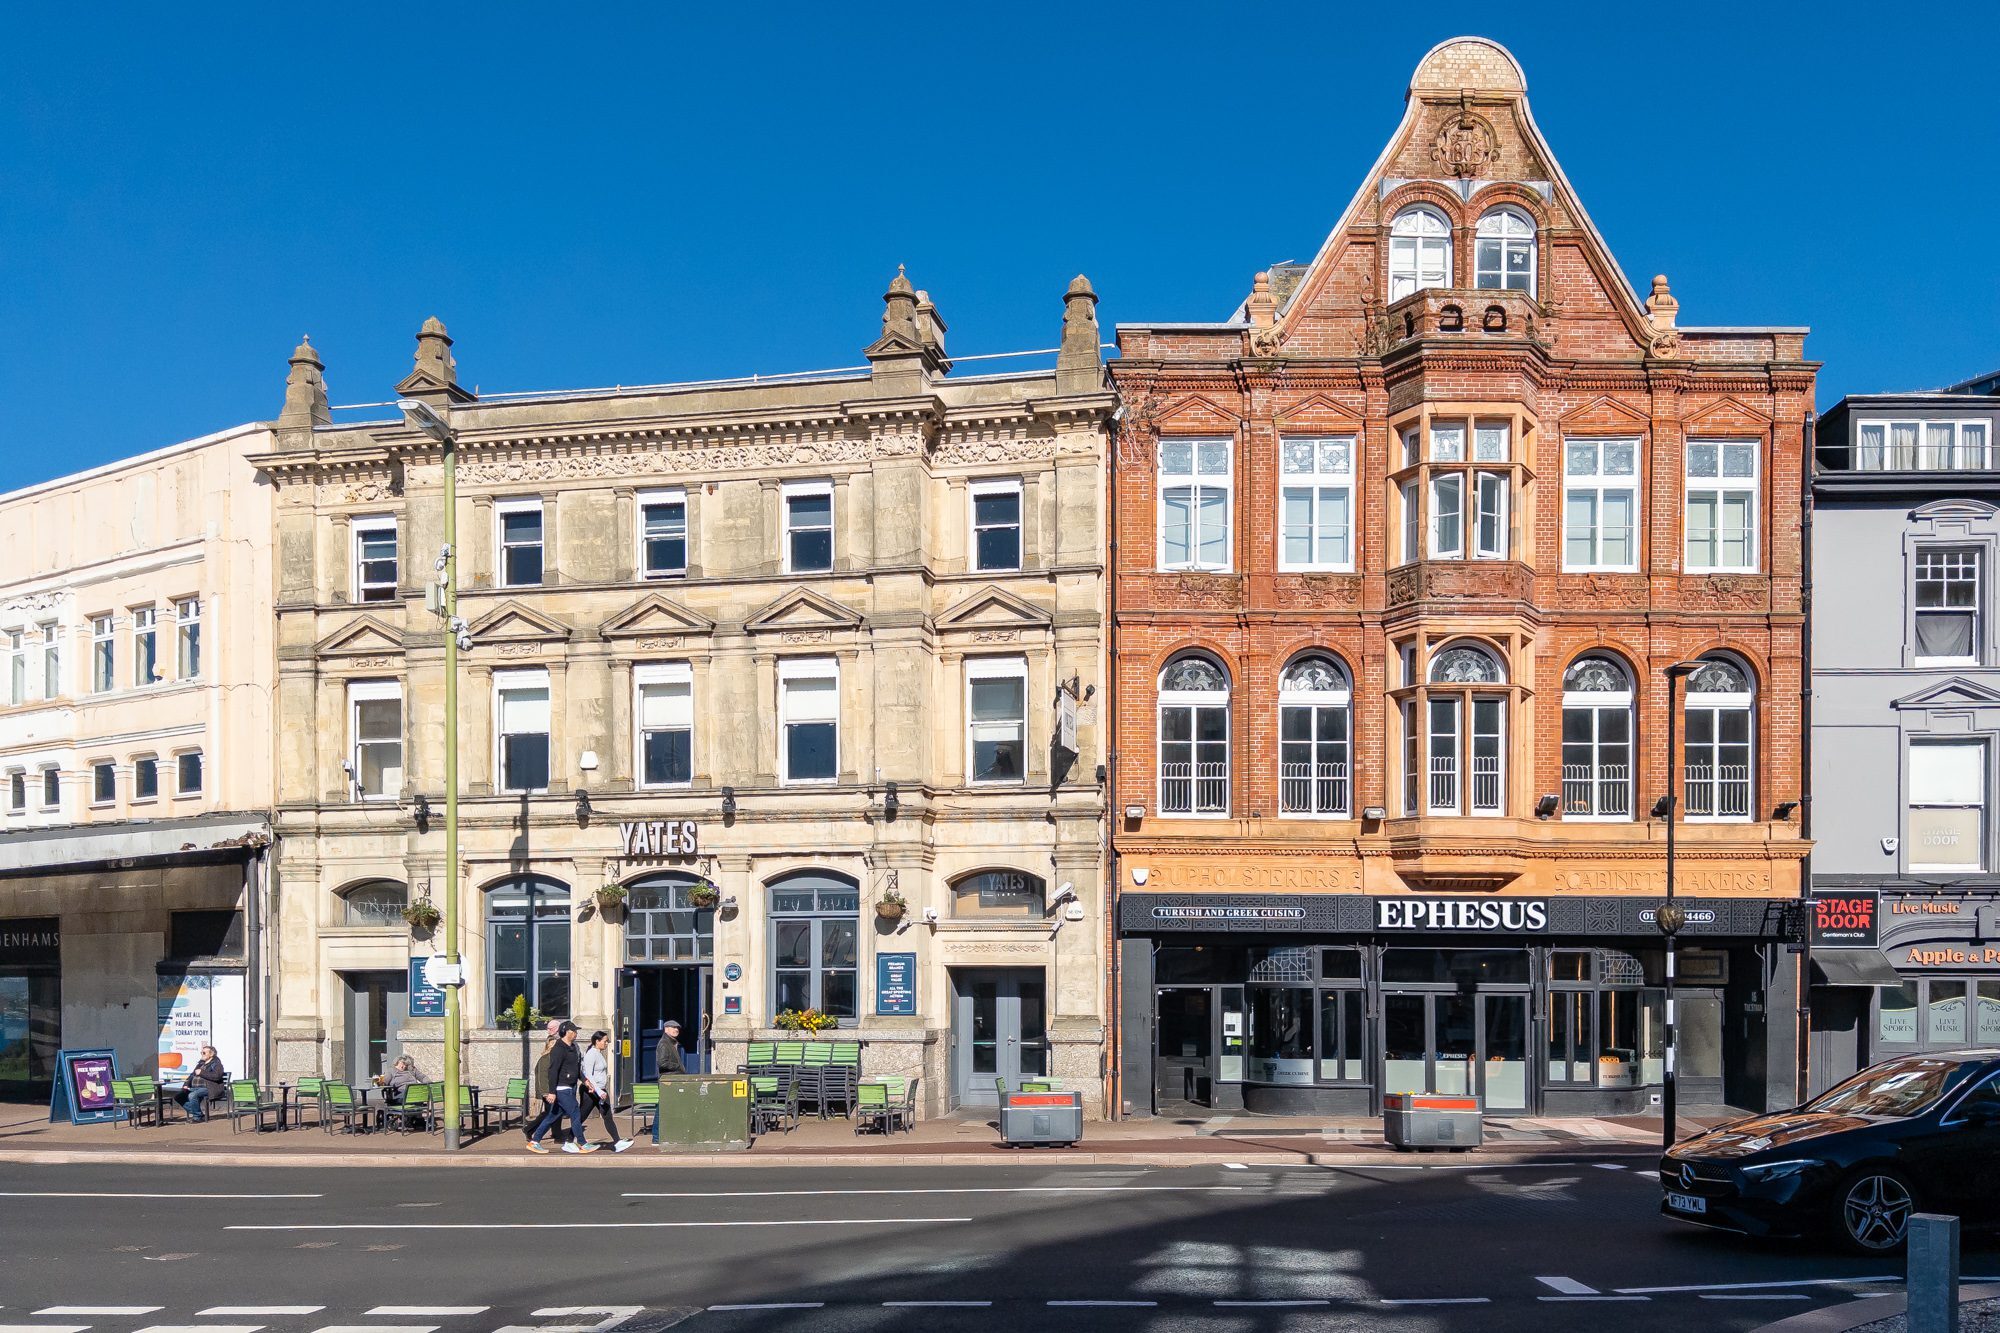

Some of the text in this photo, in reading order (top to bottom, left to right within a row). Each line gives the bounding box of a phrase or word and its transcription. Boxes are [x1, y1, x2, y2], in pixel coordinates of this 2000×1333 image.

[619, 820, 698, 855] YATES
[1922, 835, 1959, 845] DOOR
[988, 873, 1025, 890] YATES
[1169, 867, 1340, 887] UPHOLSTERERS
[1566, 870, 1654, 891] CABINET
[1158, 908, 1301, 918] TURKISH AND GREEK CUISINE
[1815, 898, 1874, 914] STAGE
[1892, 902, 1960, 914] Live Music
[1377, 900, 1547, 930] EPHESUS
[1817, 914, 1871, 929] DOOR
[0, 932, 60, 947] ENHAMS
[1906, 948, 1965, 965] Apple
[1968, 953, 1979, 963] &
[1883, 1024, 1914, 1032] SPORTS
[1935, 1024, 1960, 1032] MUSIC
[735, 1082, 745, 1096] H
